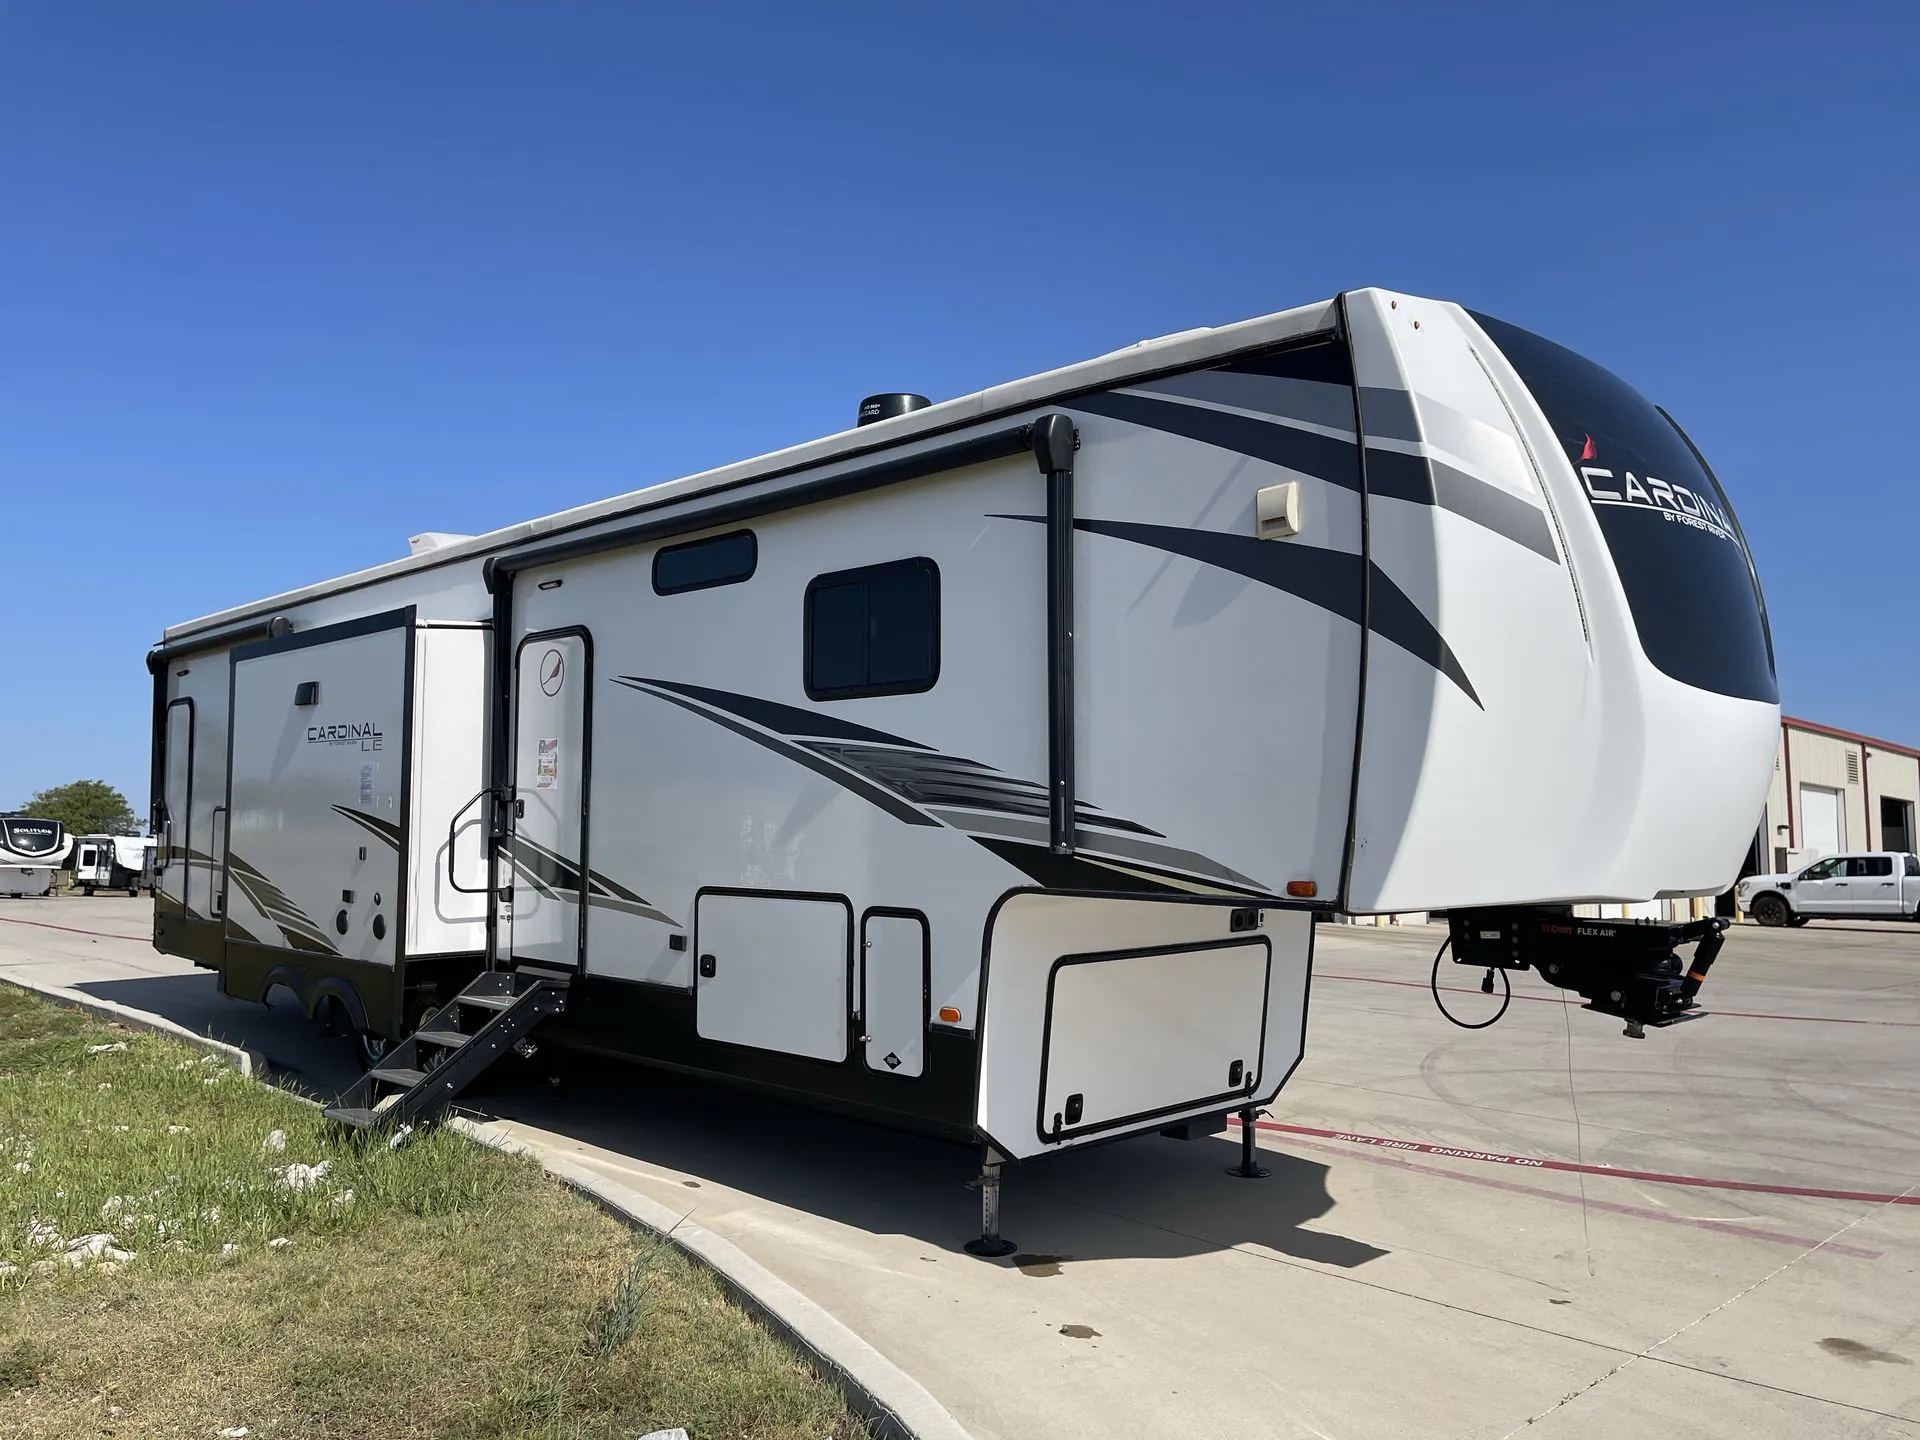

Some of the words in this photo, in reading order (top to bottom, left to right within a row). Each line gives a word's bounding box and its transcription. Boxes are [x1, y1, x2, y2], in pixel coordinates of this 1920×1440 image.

[1580, 466, 1735, 535] CARDINA
[1663, 511, 1675, 522] BY
[1676, 515, 1708, 531] FOREST
[307, 722, 383, 741] CARDINAL
[361, 739, 383, 752] LE
[1577, 926, 1598, 936] FLEX
[1599, 928, 1615, 938] AIR
[1334, 1134, 1376, 1143] LANE
[1380, 1141, 1420, 1150] FIRE
[1430, 1147, 1509, 1162] PARKING
[1515, 1158, 1544, 1166] NO
